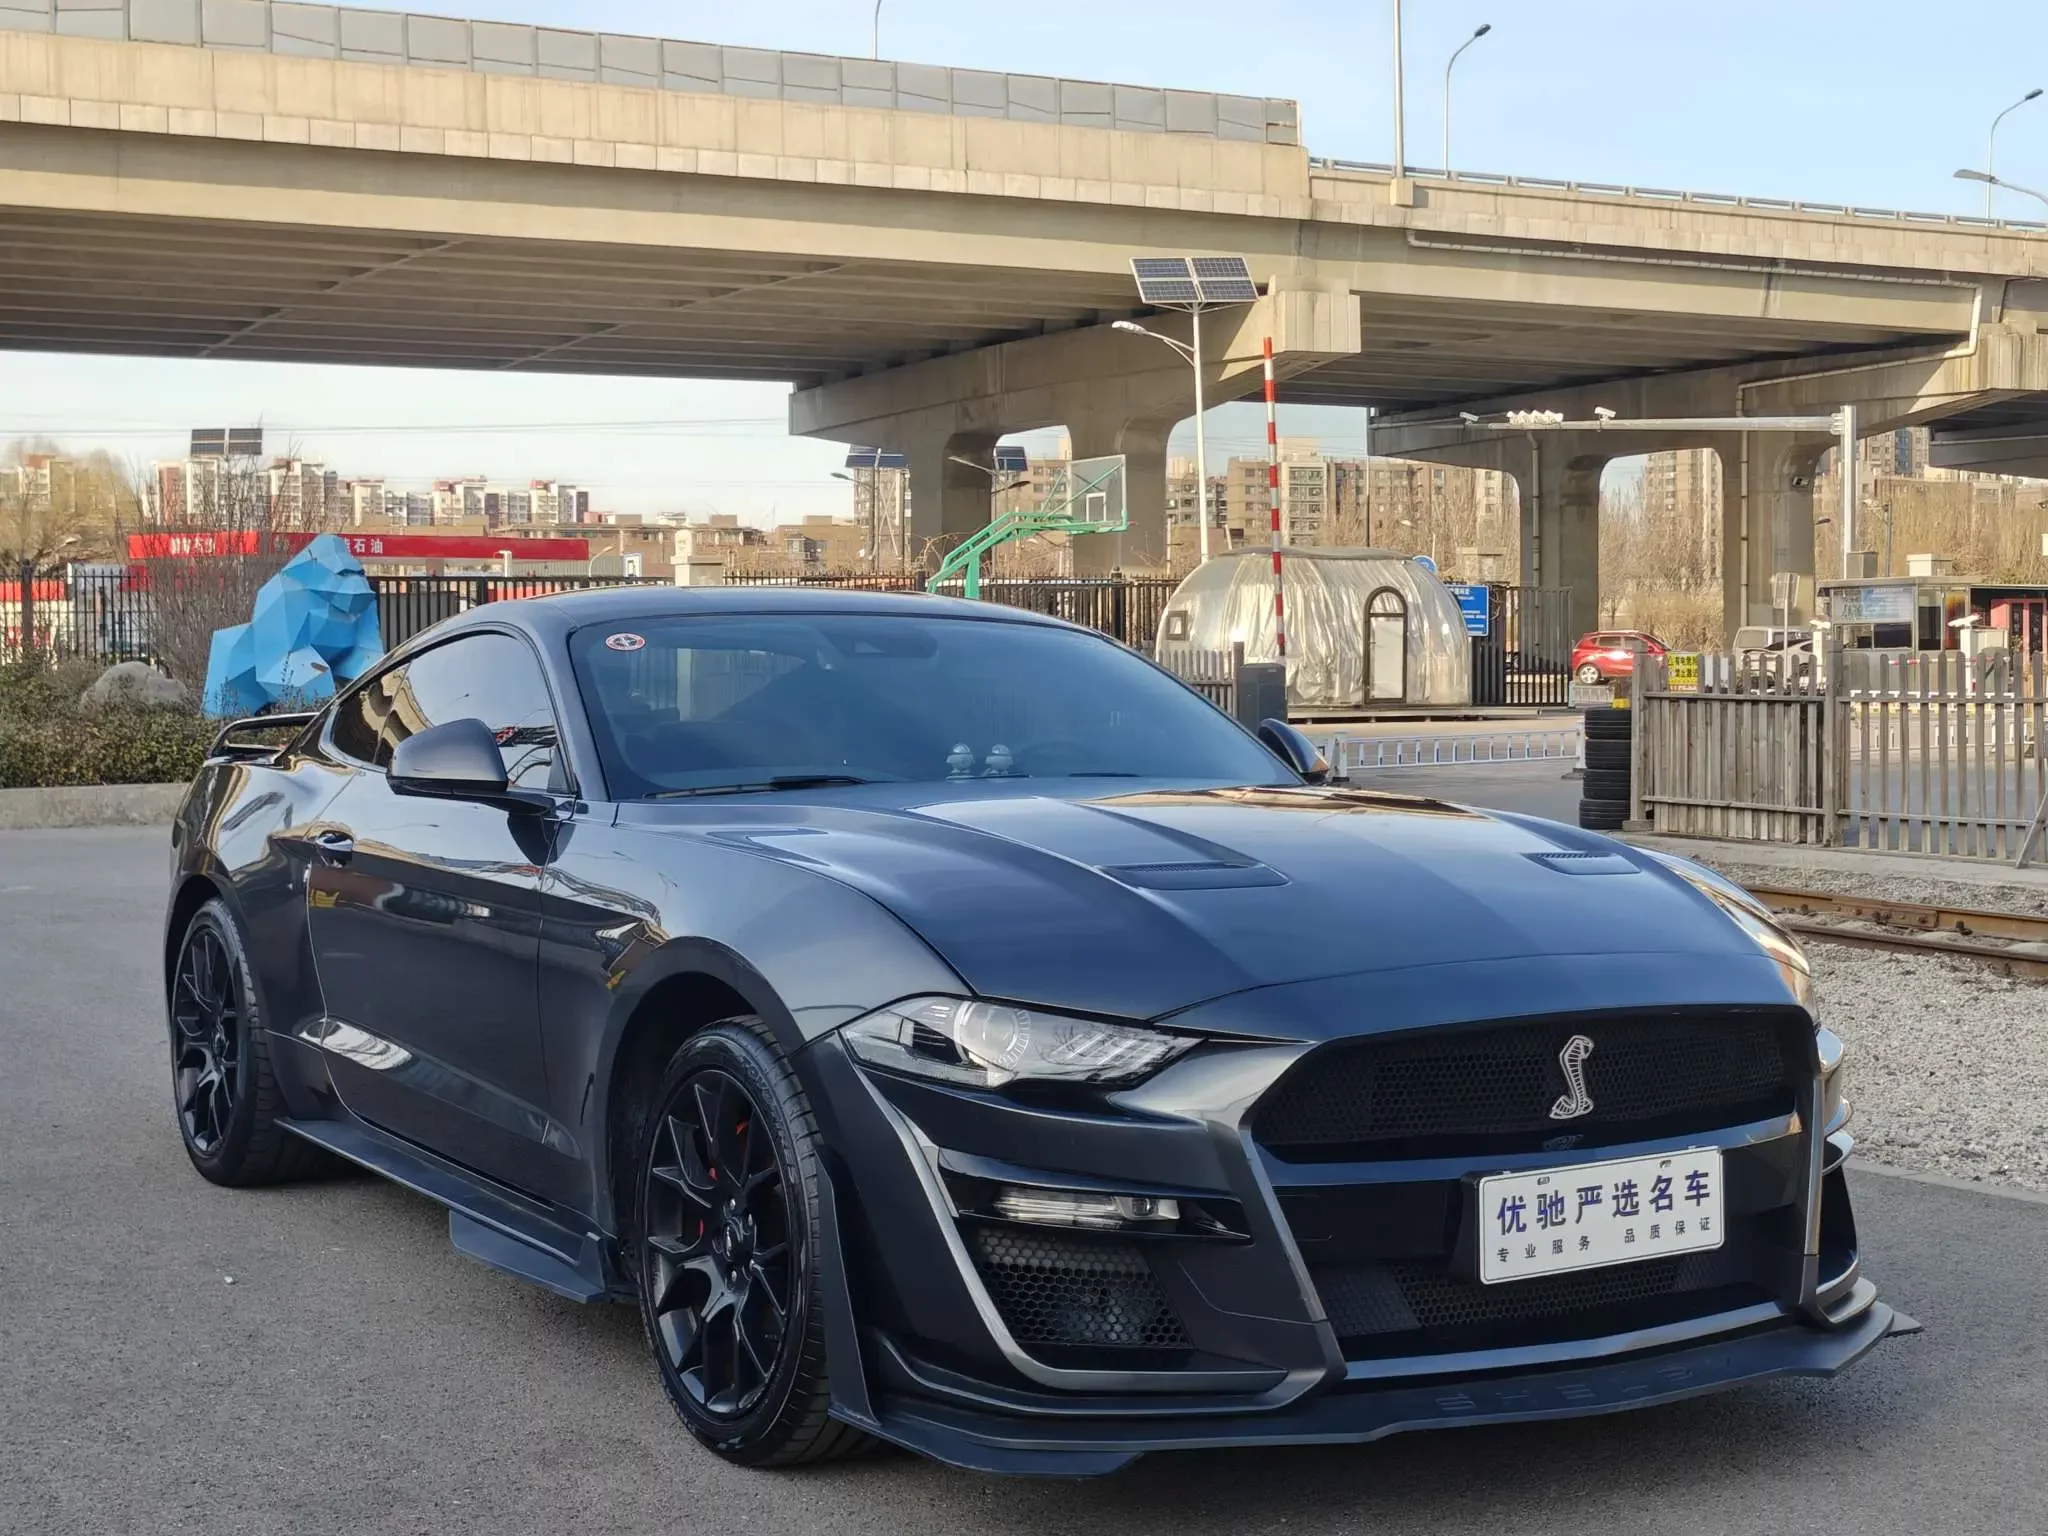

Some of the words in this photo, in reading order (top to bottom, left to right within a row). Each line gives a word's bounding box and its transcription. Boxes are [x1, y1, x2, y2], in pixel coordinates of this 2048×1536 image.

[1497, 1170, 1711, 1236] 优驰严选名车
[1497, 1235, 1590, 1263] 专业服务
[1624, 1217, 1711, 1244] 品质保证
